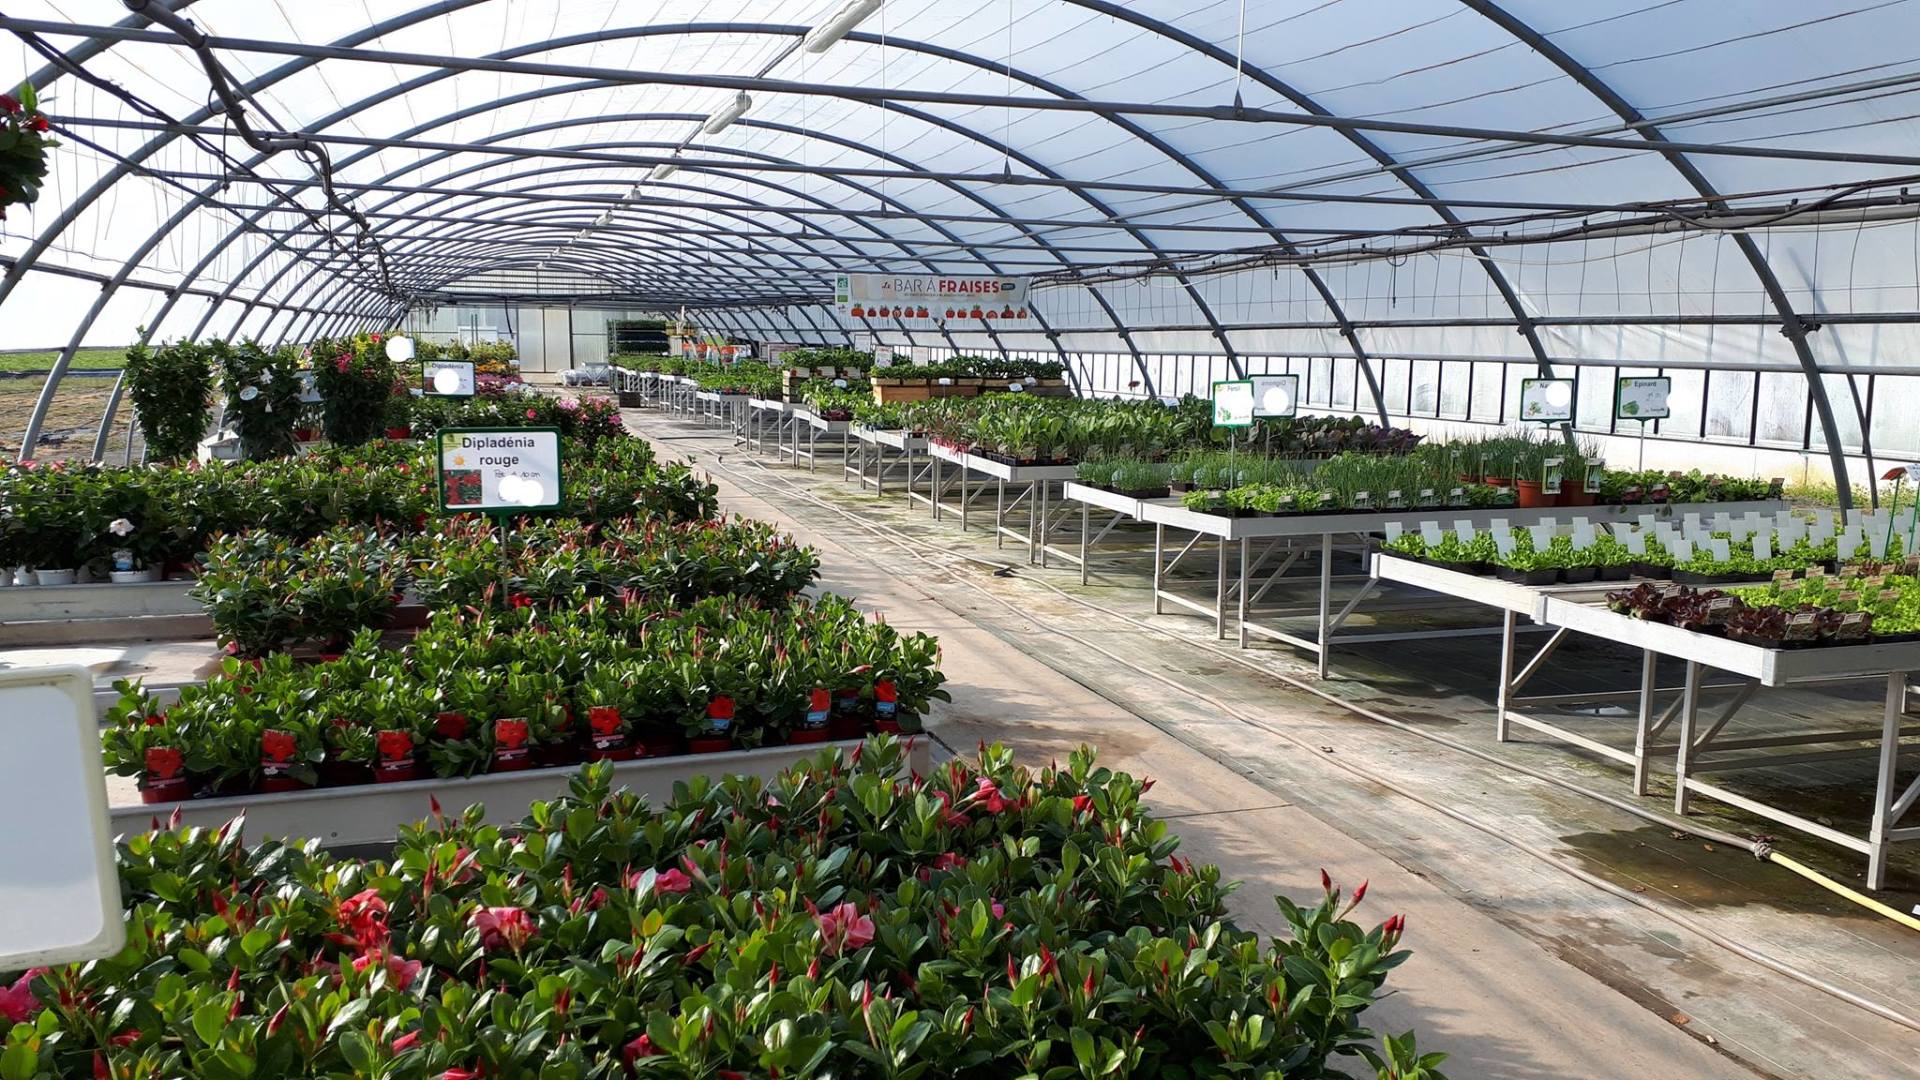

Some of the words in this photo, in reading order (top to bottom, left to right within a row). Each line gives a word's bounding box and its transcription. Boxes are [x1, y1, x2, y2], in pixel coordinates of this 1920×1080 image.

[894, 279, 922, 293] BAR
[926, 276, 936, 293] À
[939, 280, 999, 294] FRAISES
[462, 436, 535, 450] Dipladénia
[479, 457, 519, 468] rouge
